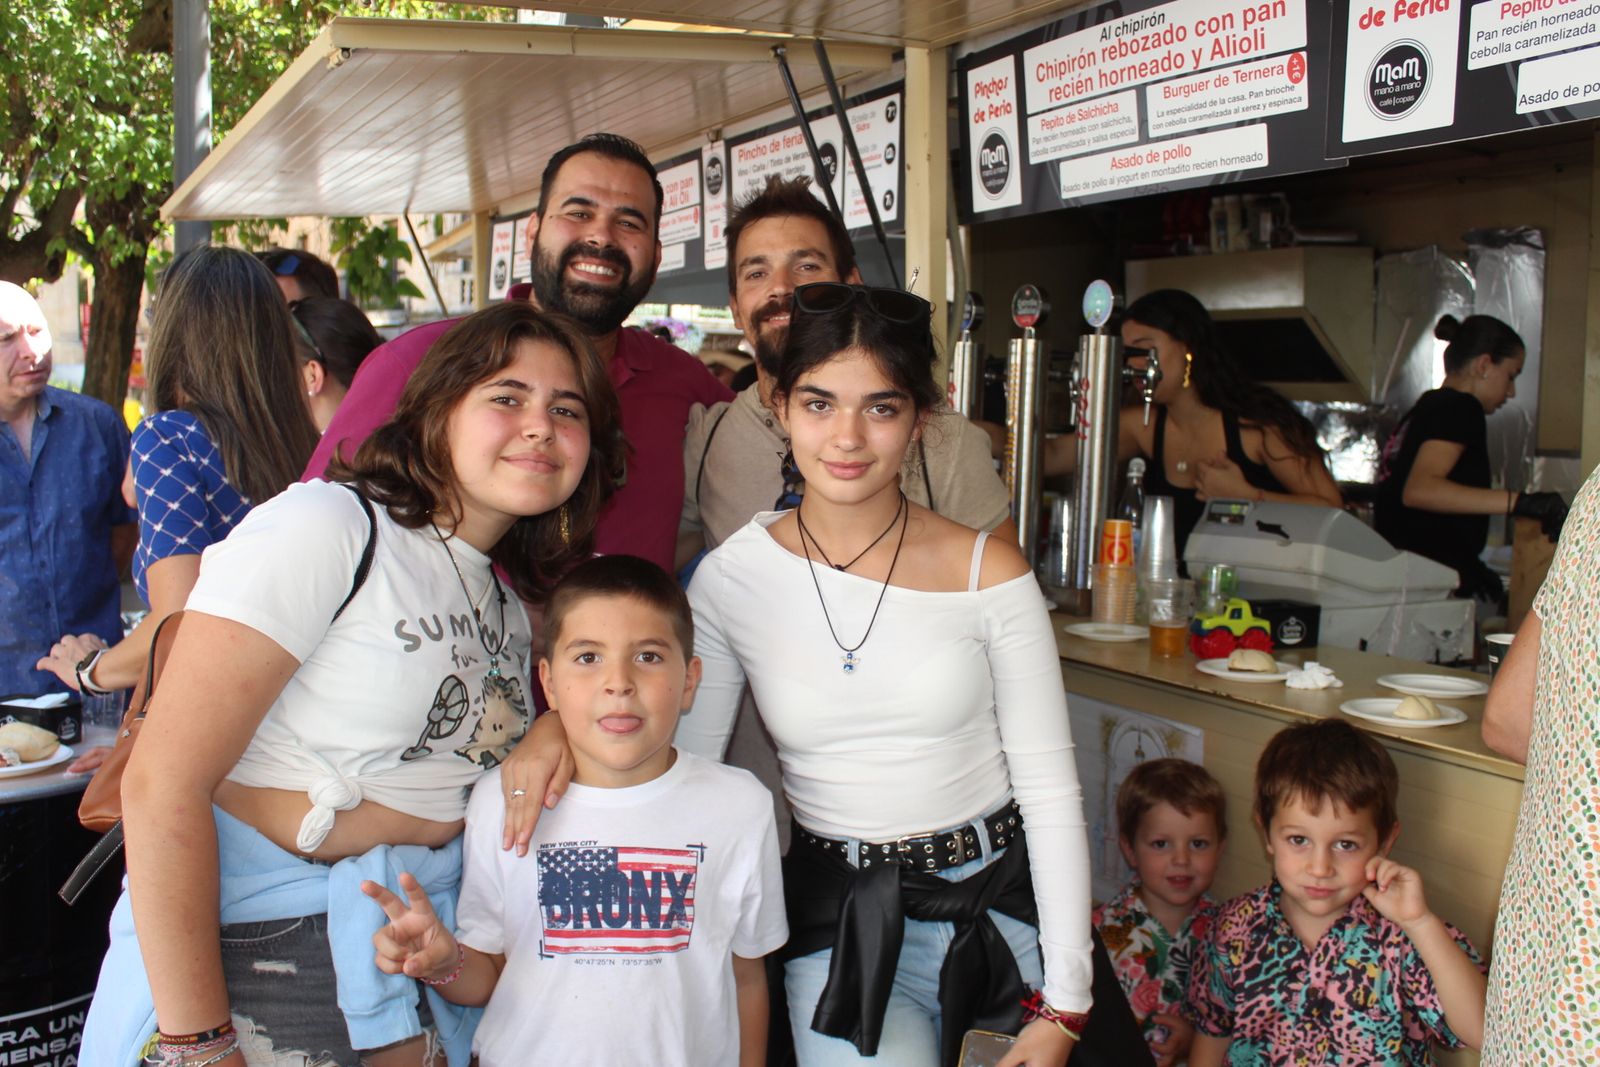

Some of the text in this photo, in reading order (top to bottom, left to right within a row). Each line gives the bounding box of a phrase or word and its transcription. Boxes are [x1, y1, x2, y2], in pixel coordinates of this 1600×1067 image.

[1359, 6, 1386, 30] de
[1477, 4, 1600, 42] Pan recién horneado
[1500, 0, 1553, 20] Pepito
[1036, 0, 1286, 83] Chipirón rebozado con pan
[1100, 12, 1165, 42] Al chipirón
[1470, 22, 1596, 60] cebolla caramelizada
[1049, 27, 1265, 102] recién horneado y Alioli
[974, 77, 1008, 99] Pinchos
[1163, 64, 1284, 98] Burguer de Ternera
[1519, 89, 1559, 107] Asado
[1563, 85, 1579, 98] de
[974, 107, 985, 124] de
[1040, 101, 1119, 131] Pepito de Salchicha
[1166, 100, 1207, 118] especialidad
[1209, 99, 1218, 107] de
[1219, 97, 1226, 105] la
[1249, 91, 1264, 100] Pan
[1265, 84, 1296, 96] brioche
[1188, 109, 1232, 124] caramelizada
[1241, 103, 1261, 112] xerez
[1262, 102, 1267, 110] y
[1268, 95, 1302, 109] espinaca
[738, 144, 767, 162] Pincho
[769, 138, 780, 153] de
[783, 132, 804, 149] feria
[1110, 144, 1192, 170] Asado de pollo
[1140, 171, 1150, 179] en
[1220, 151, 1263, 165] horneado
[542, 870, 694, 929] BRONX
